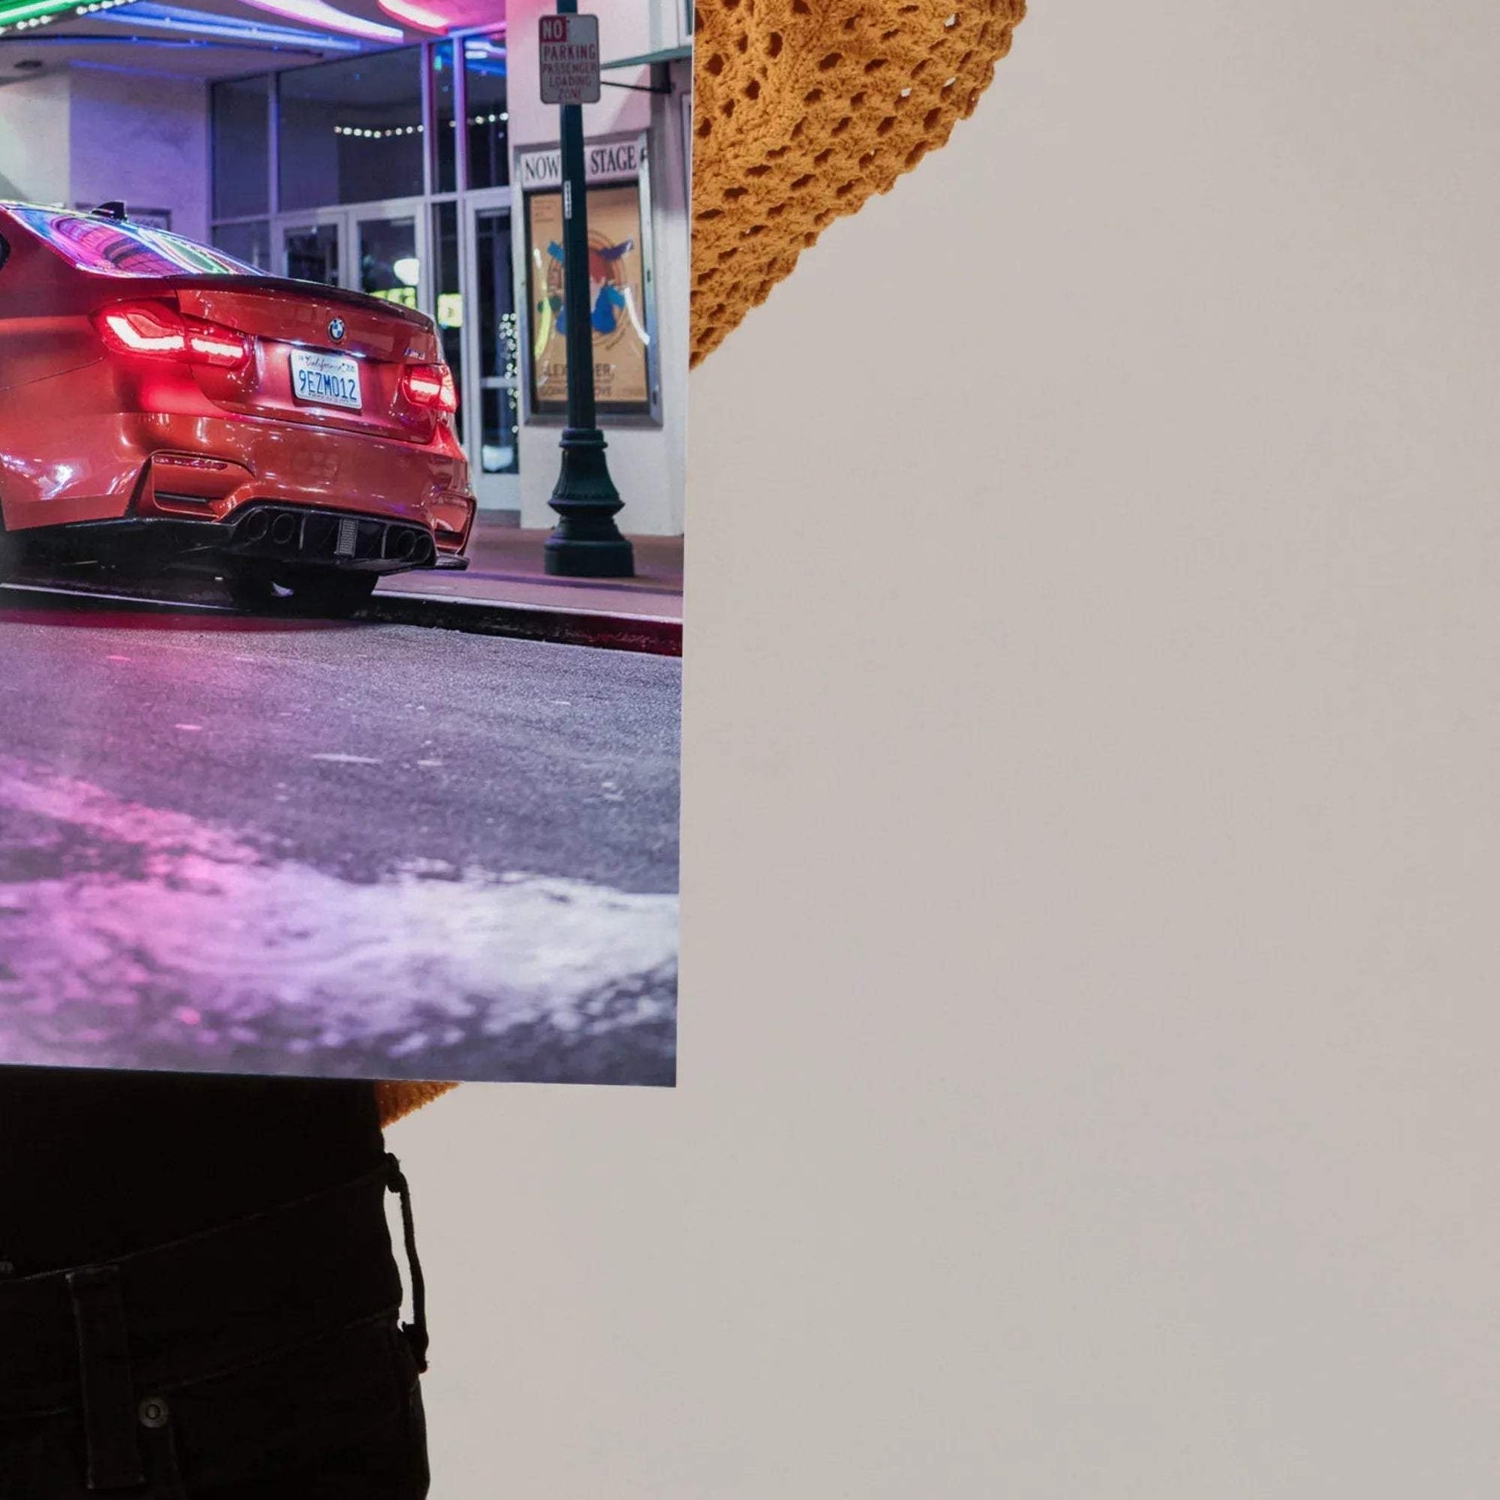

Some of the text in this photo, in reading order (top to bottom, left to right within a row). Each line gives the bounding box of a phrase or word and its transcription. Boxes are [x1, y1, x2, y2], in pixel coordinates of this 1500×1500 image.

[542, 18, 564, 40] NO
[543, 43, 597, 61] PARKING
[542, 62, 598, 76] PASSENGER
[549, 75, 592, 88] LOADING
[525, 144, 637, 181] NOW STAGE
